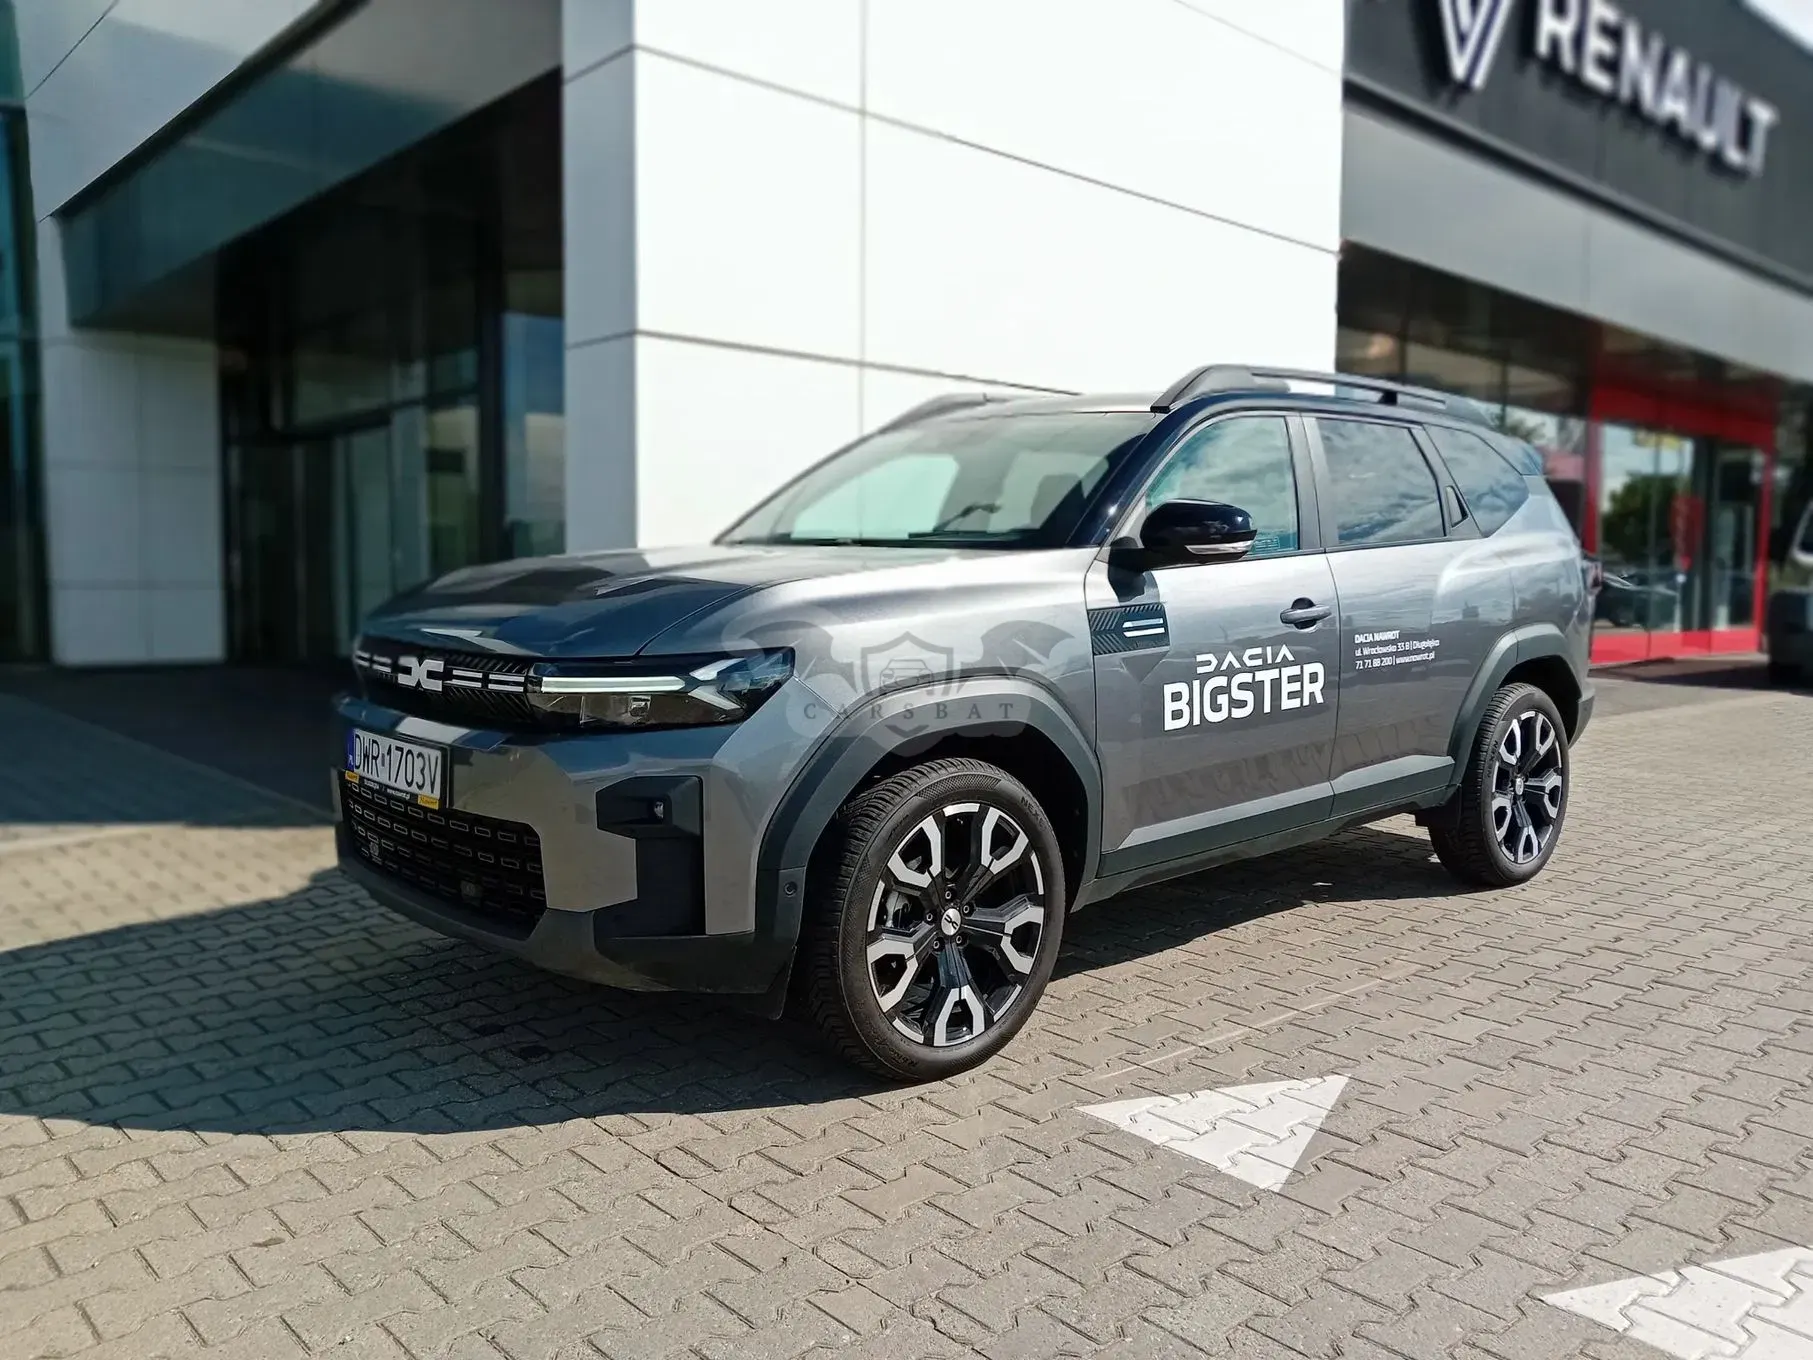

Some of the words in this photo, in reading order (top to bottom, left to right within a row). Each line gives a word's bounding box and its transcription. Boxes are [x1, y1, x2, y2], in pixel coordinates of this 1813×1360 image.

[1535, 0, 1780, 177] RENAULT
[1355, 632, 1373, 643] DACIA
[1374, 630, 1400, 641] NAWROT
[1397, 642, 1404, 651] 33
[1196, 644, 1295, 674] DACIA
[1356, 660, 1364, 669] 71
[1364, 659, 1372, 668] 71
[1381, 656, 1392, 666] 200
[1163, 662, 1325, 731] BIGSTER
[354, 734, 380, 777] DWR
[386, 744, 438, 794] 1703V
